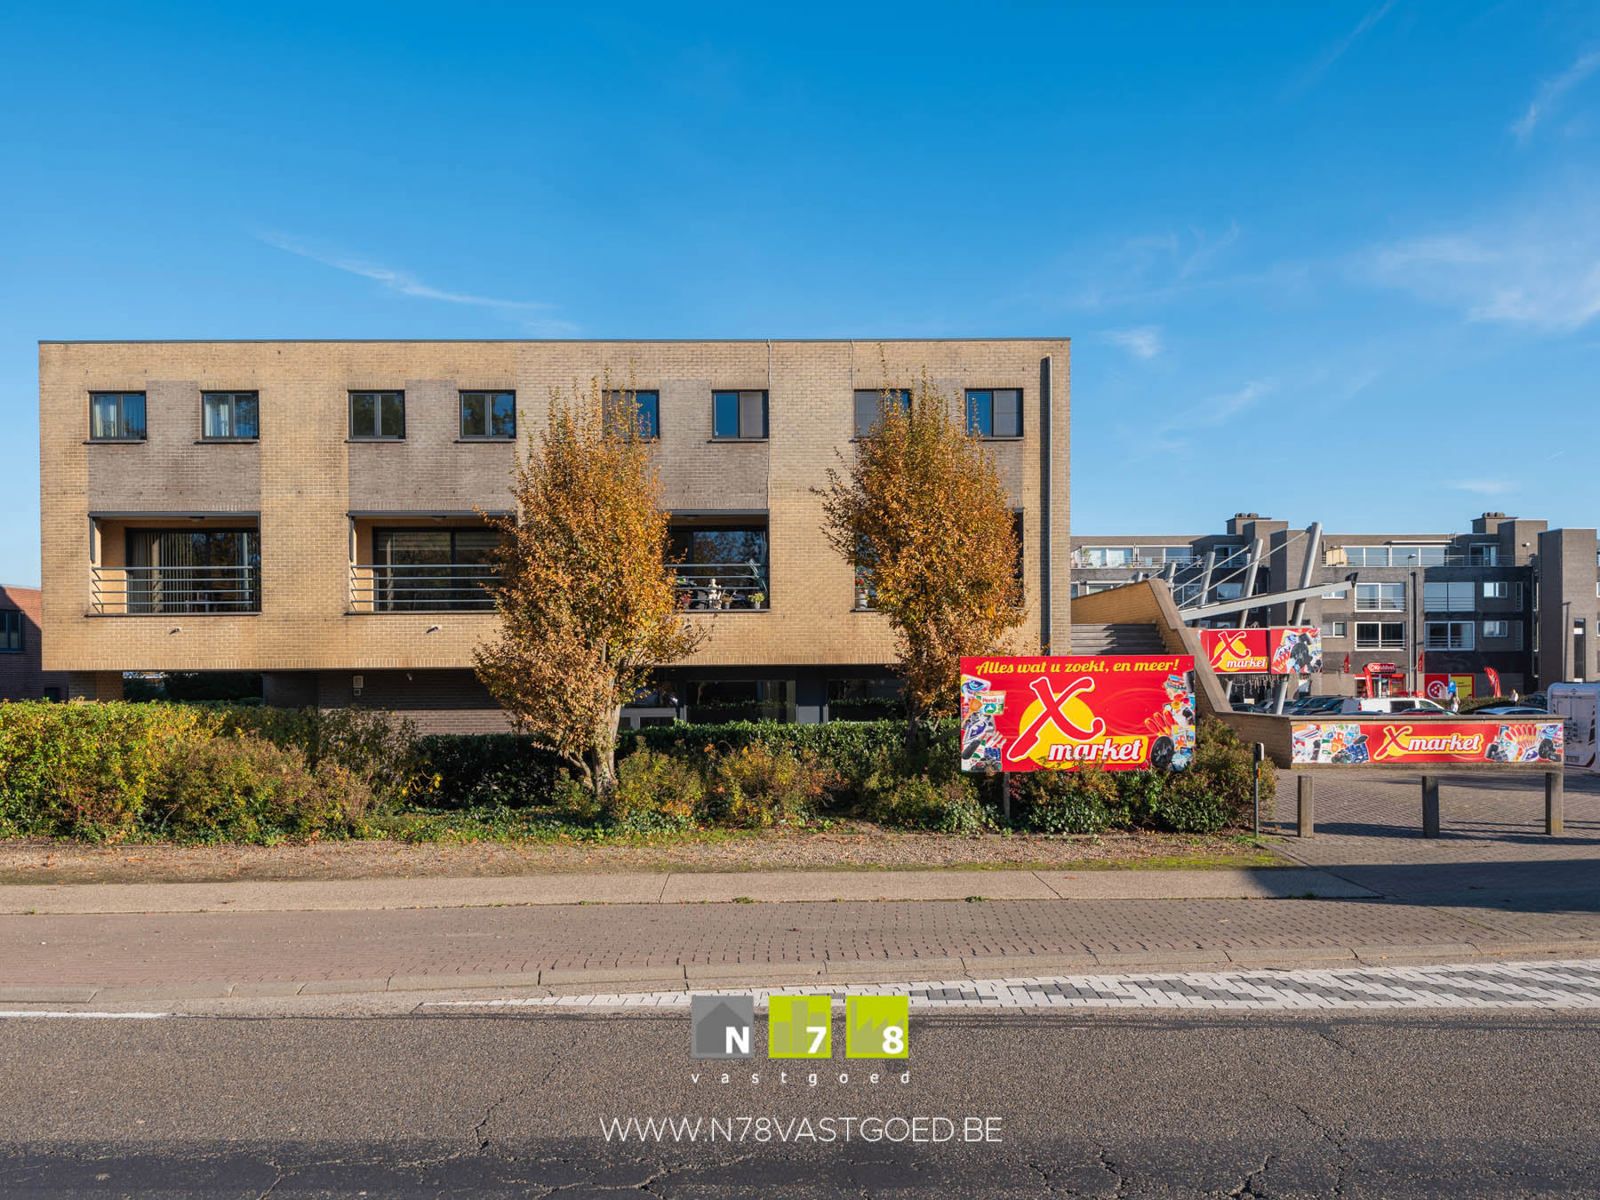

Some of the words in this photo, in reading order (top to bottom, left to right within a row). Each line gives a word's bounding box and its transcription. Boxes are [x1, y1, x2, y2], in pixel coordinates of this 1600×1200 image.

[976, 661, 1014, 675] Alles
[1017, 661, 1046, 673] wat
[1051, 663, 1061, 673] u
[1064, 660, 1109, 673] zoekt,
[1113, 662, 1130, 672] en
[1134, 658, 1179, 672] meer!
[1048, 738, 1142, 761] market
